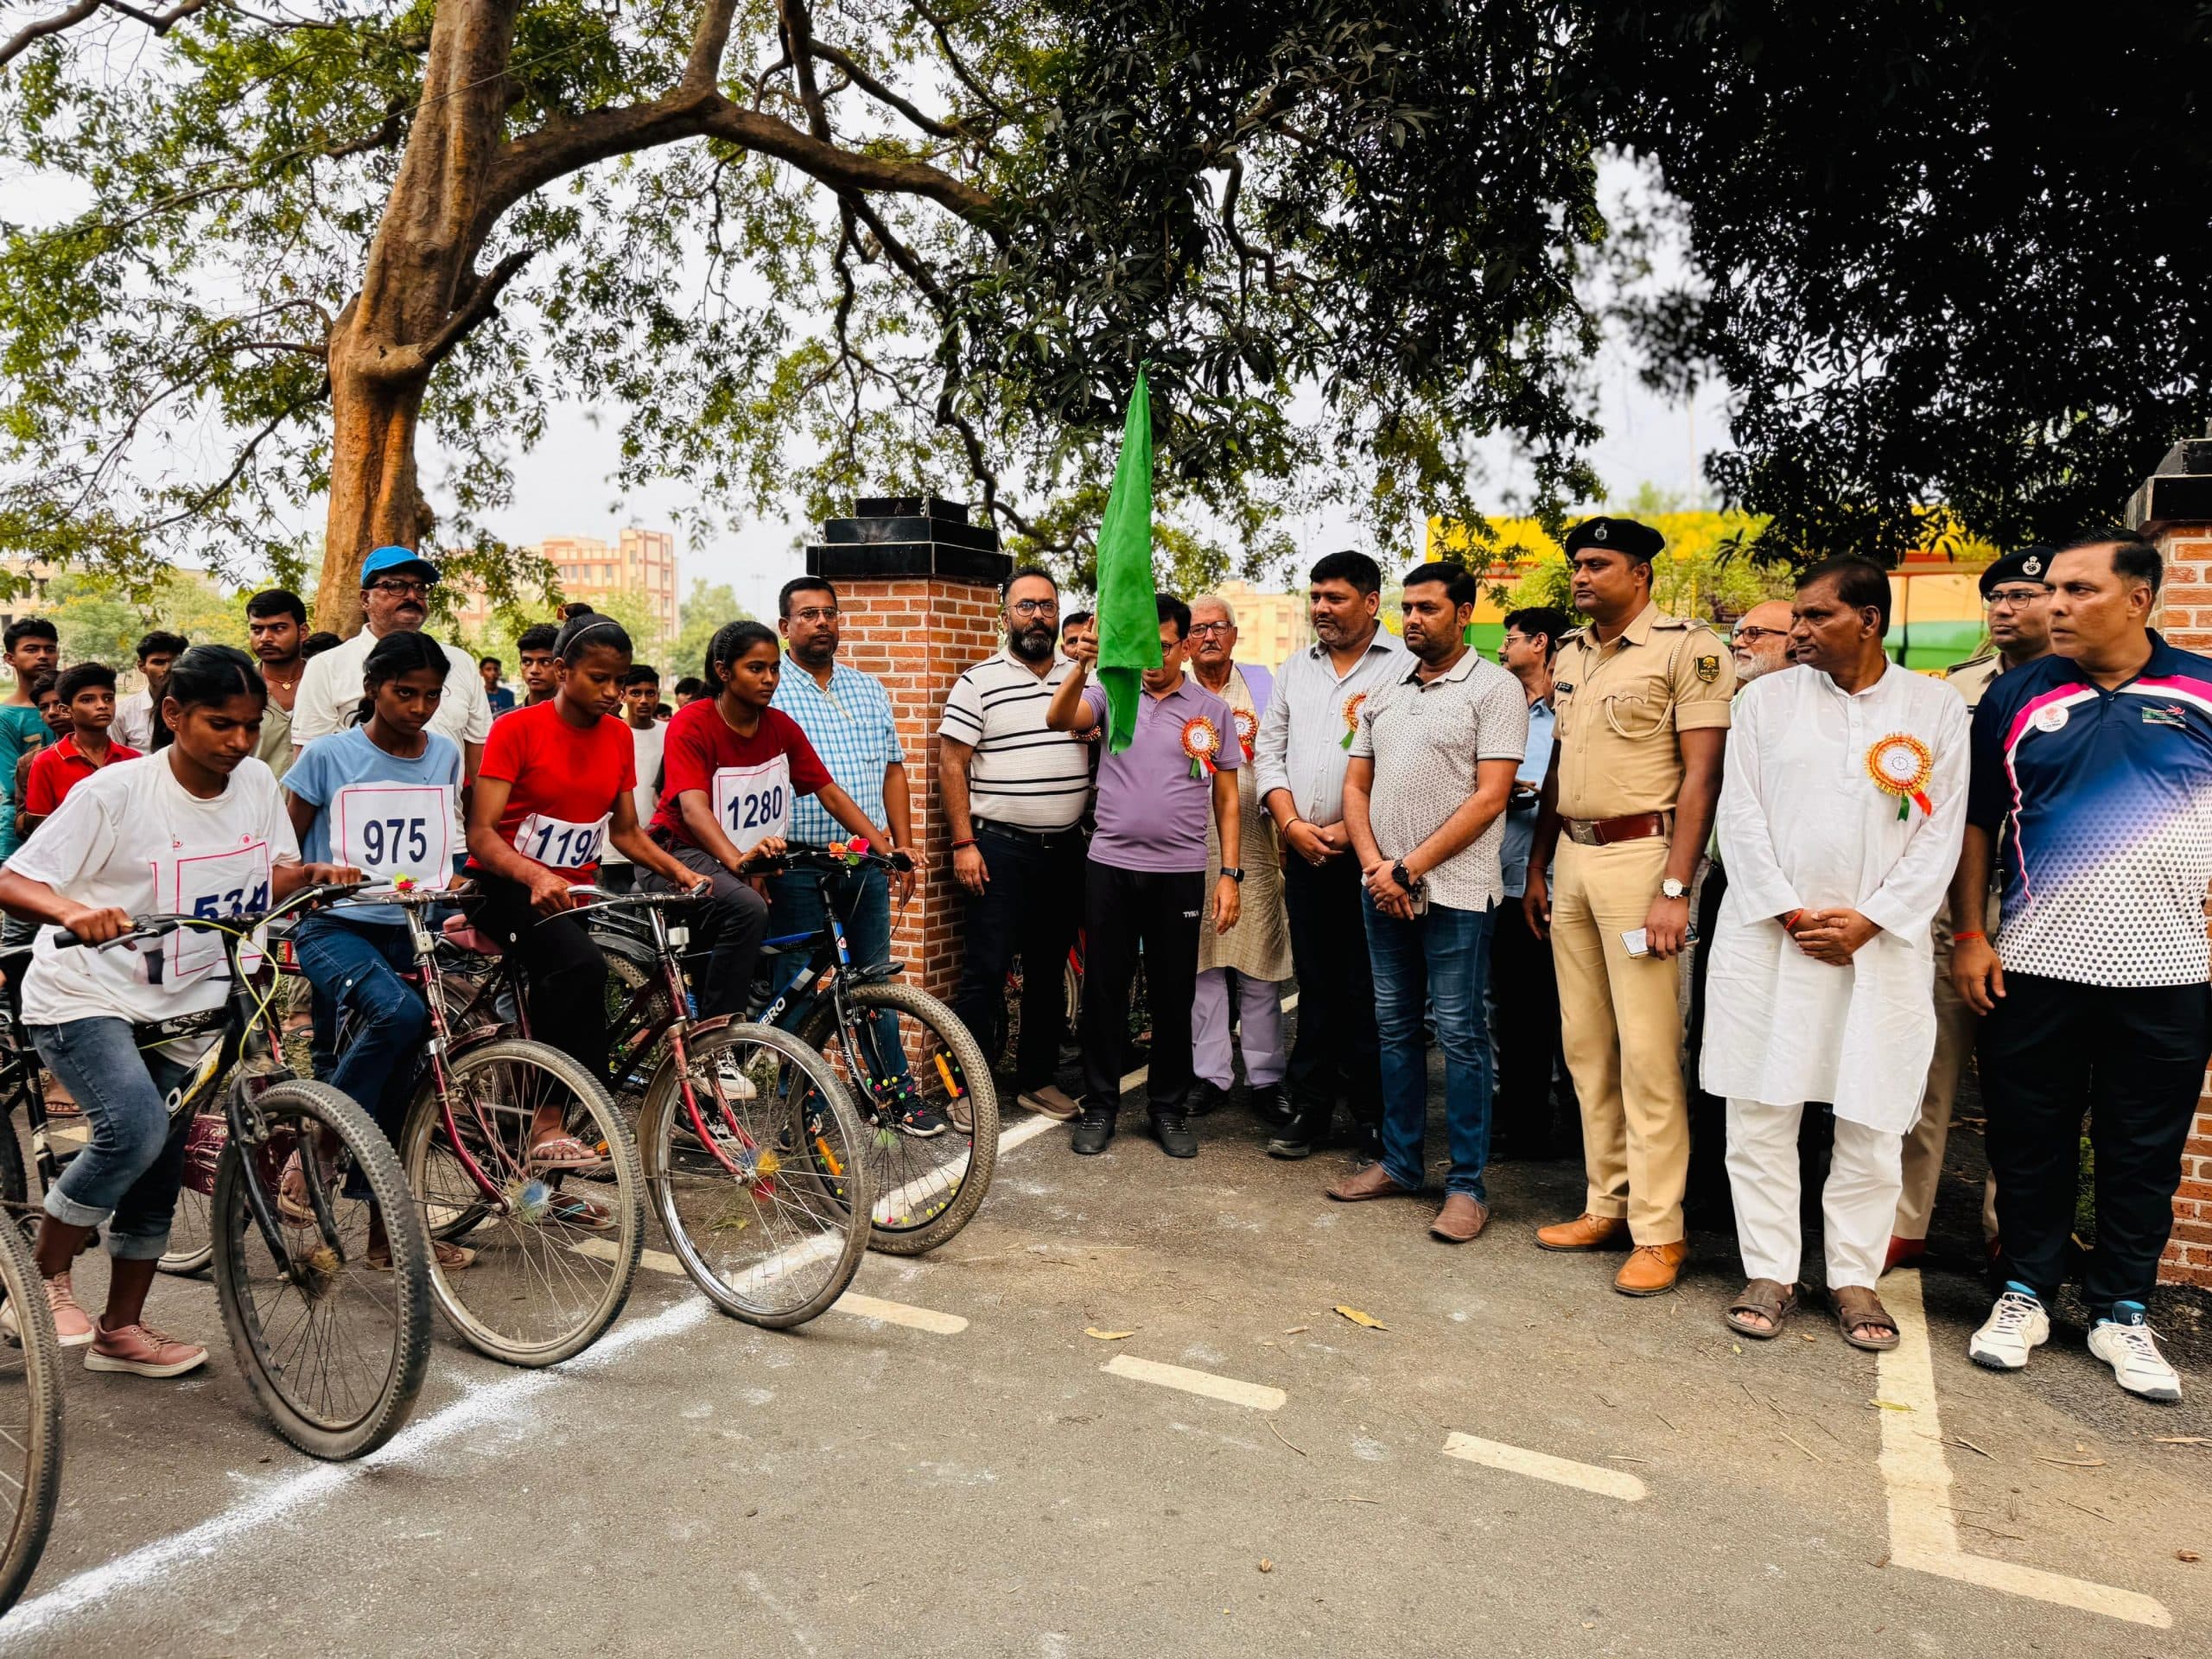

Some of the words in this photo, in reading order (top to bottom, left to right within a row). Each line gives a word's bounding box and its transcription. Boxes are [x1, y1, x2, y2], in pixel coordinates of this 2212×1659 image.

[728, 785, 783, 831] 1280
[363, 817, 428, 866] 975
[536, 823, 601, 867] 1192
[760, 996, 786, 1026] ERO
